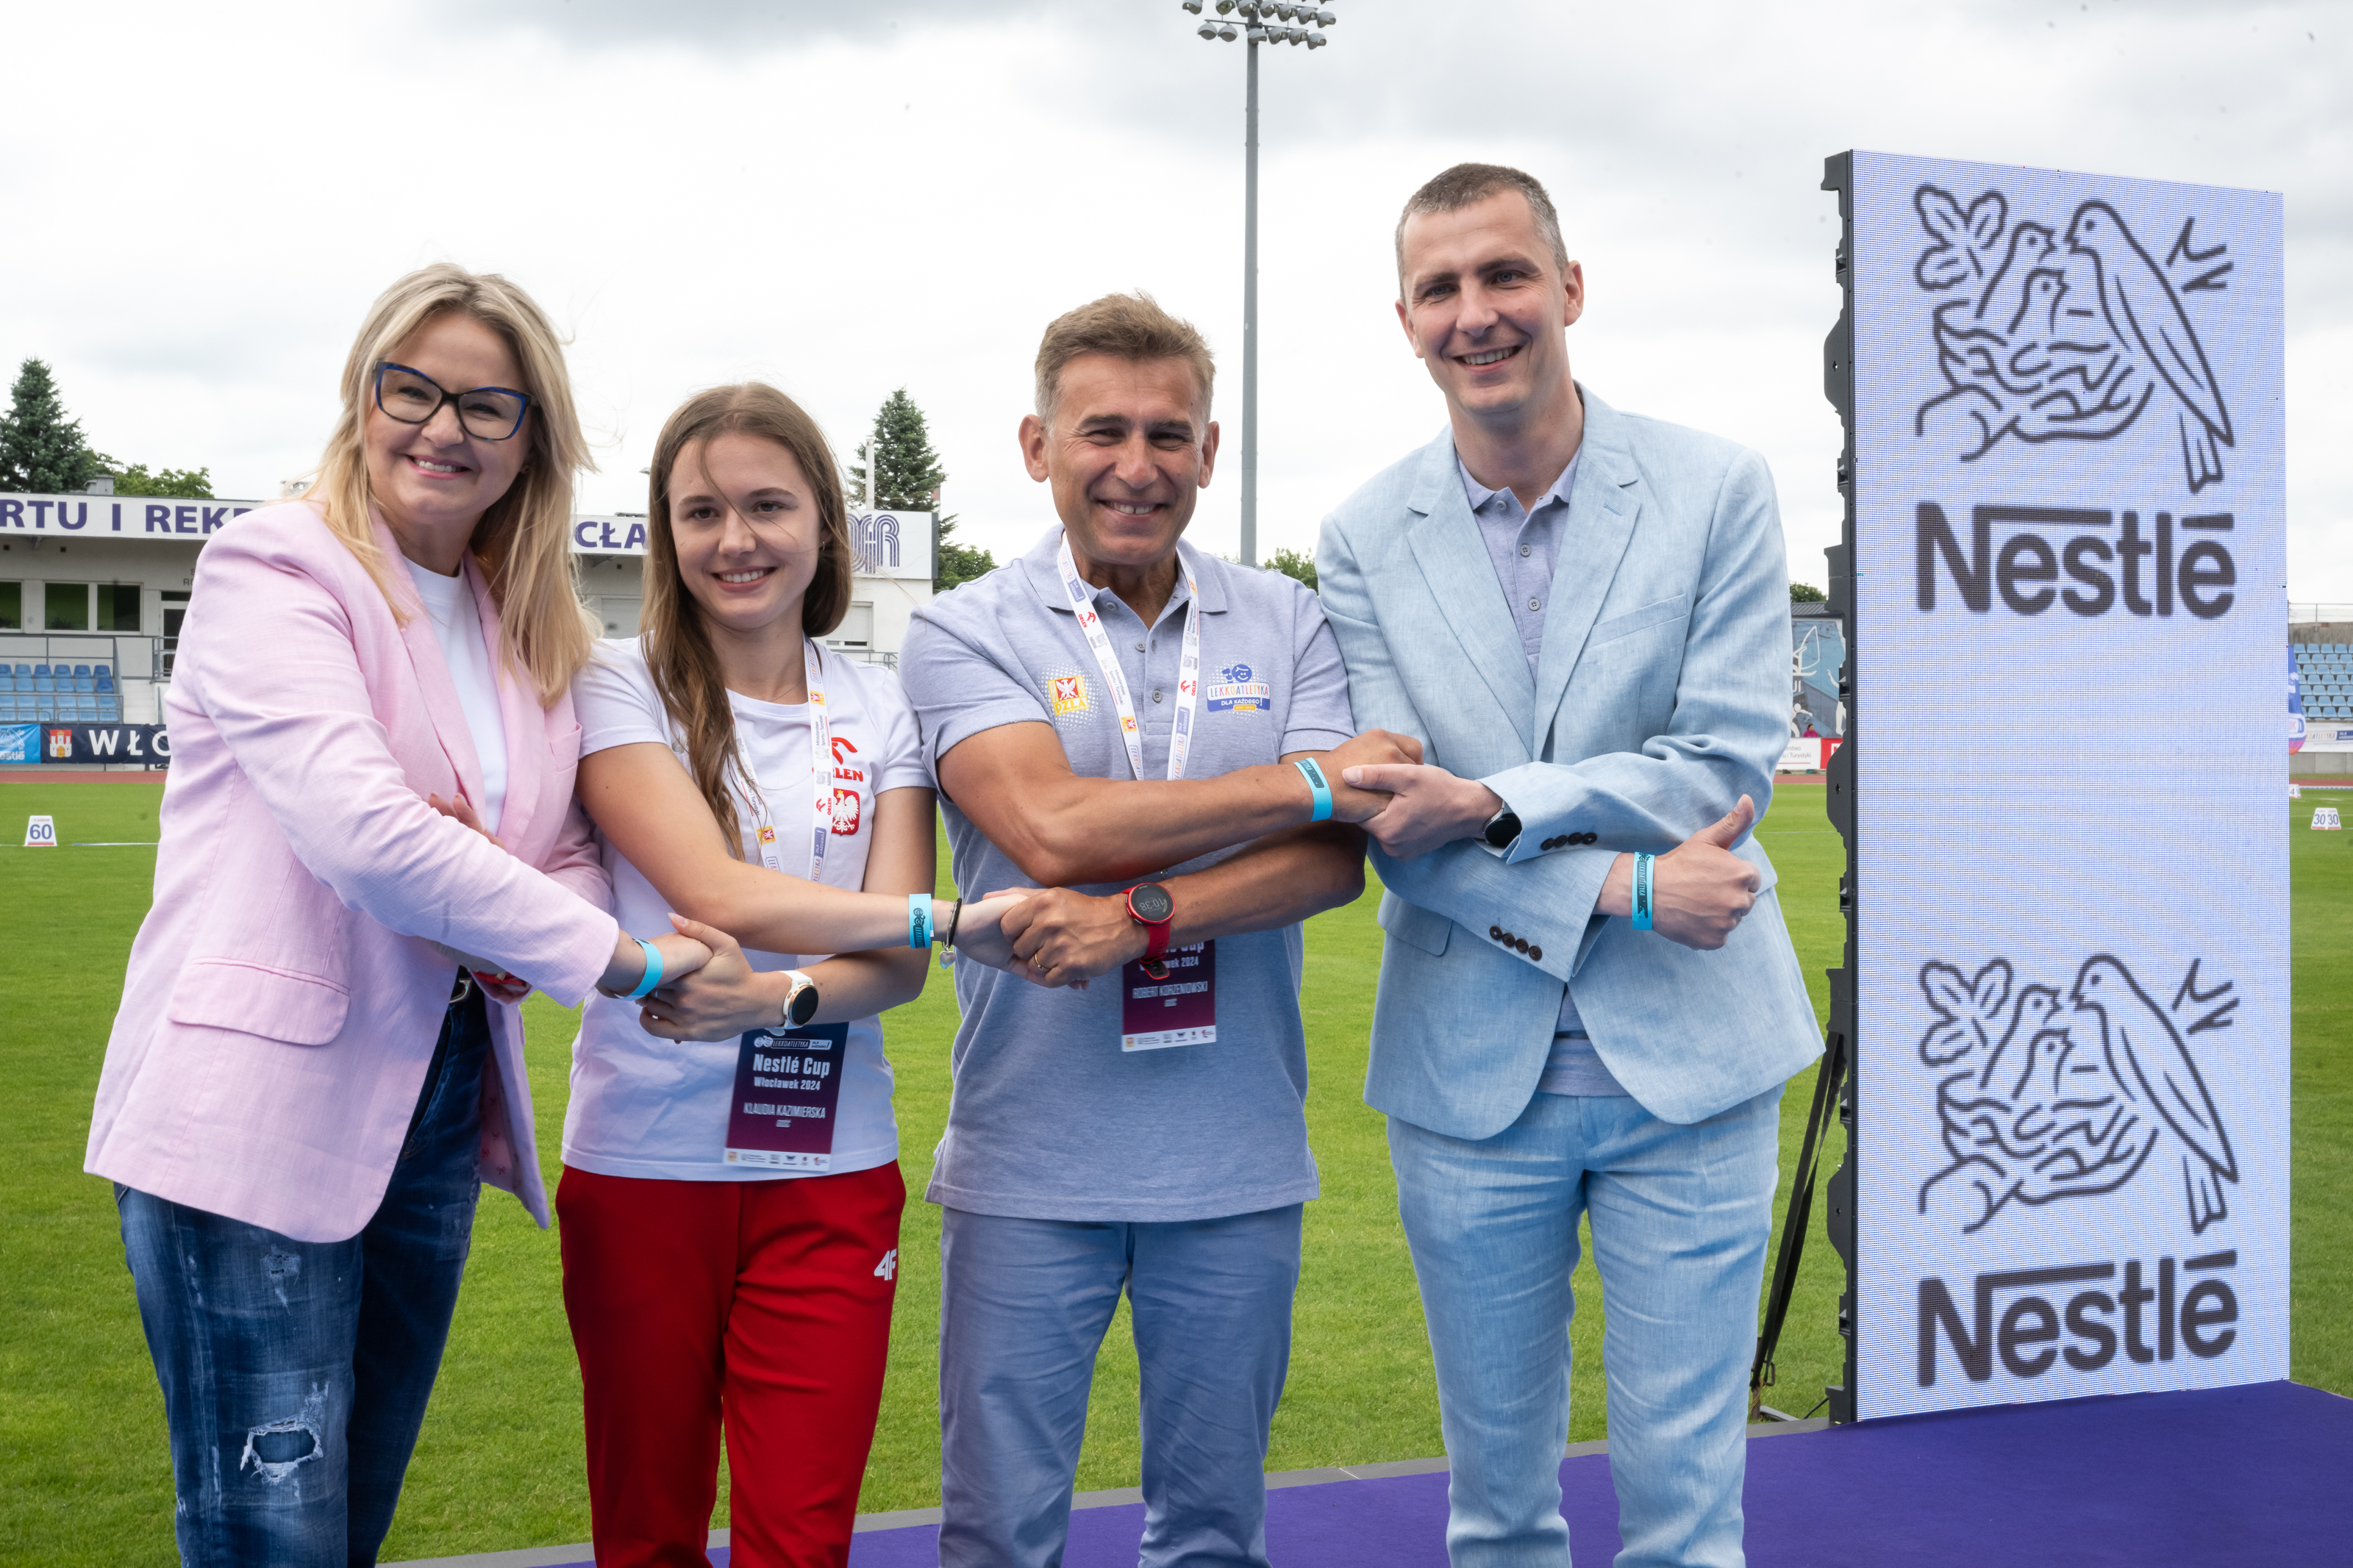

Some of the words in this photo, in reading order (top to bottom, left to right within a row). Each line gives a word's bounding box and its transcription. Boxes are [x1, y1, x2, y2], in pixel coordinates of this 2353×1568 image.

[0, 499, 88, 530] RTU
[112, 504, 121, 531] I
[145, 504, 254, 534] REK
[1915, 501, 2236, 619] Nestlé
[1078, 614, 1088, 628] ORLEN
[1114, 669, 1126, 696] Ministerstwo
[1210, 685, 1268, 698] LEKKOATLETYKA
[1054, 698, 1087, 713] PZLA
[88, 729, 171, 756] WŁO
[812, 767, 863, 782] LEN
[2313, 814, 2326, 825] 30
[2327, 814, 2339, 825] 30
[29, 824, 52, 840] 60
[768, 859, 778, 872] LEK
[1181, 956, 1199, 967] 2024
[753, 1053, 799, 1073] Nestlé
[803, 1057, 830, 1078] Cup
[754, 1076, 799, 1089] Włocławek
[800, 1079, 821, 1091] 2024
[874, 1248, 897, 1281] 4F
[1917, 1250, 2238, 1388] Nestlé
